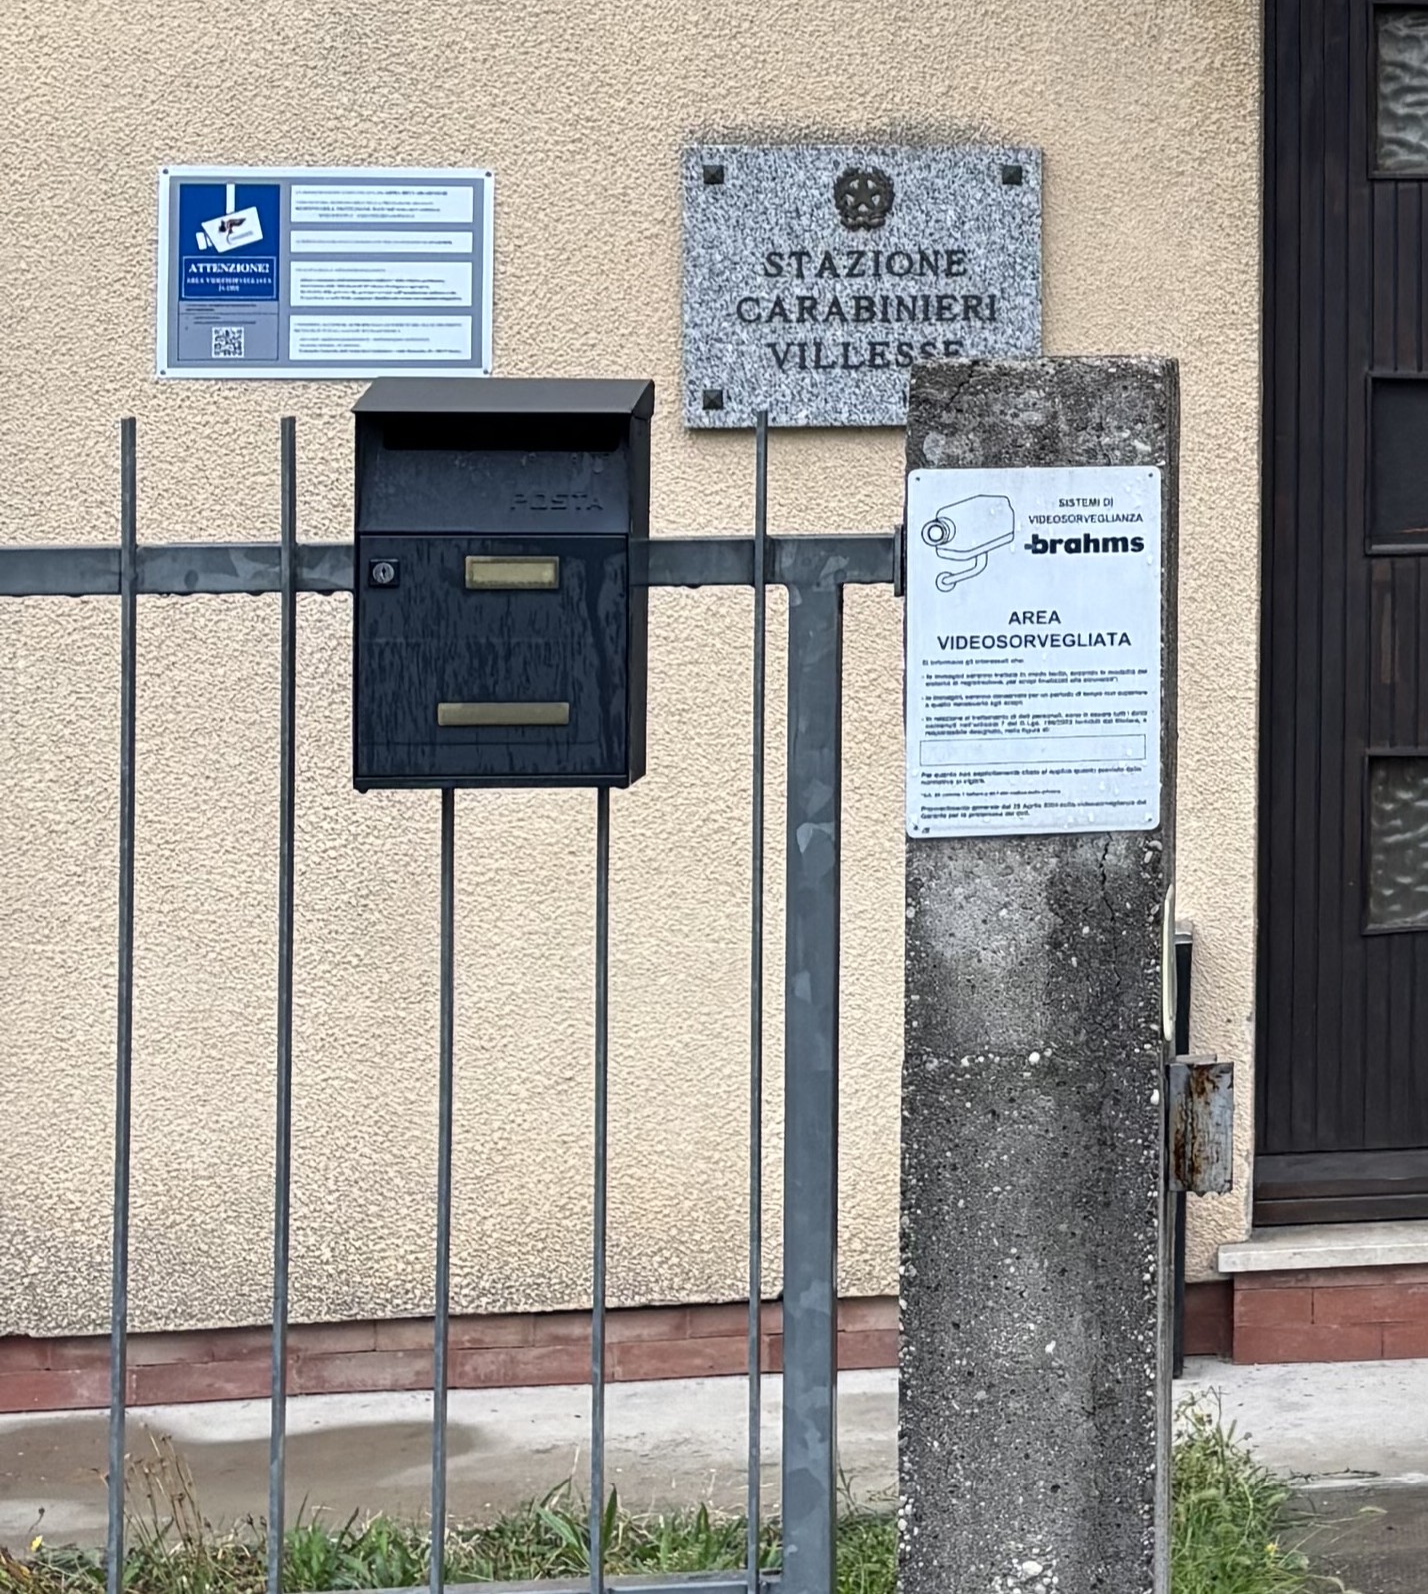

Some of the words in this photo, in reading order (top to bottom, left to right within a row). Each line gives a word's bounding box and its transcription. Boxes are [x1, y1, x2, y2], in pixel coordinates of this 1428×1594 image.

[762, 249, 968, 279] STAZIONE
[736, 293, 998, 324] CARABINIERI
[1058, 498, 1100, 508] SISTEMI
[1103, 497, 1114, 508] DI
[1028, 513, 1144, 525] VIDEOSORVEGLIANZA
[1031, 533, 1145, 555] brahms
[1008, 610, 1062, 625] AREA
[937, 632, 1132, 650] VIDEOSORVEGLIATA
